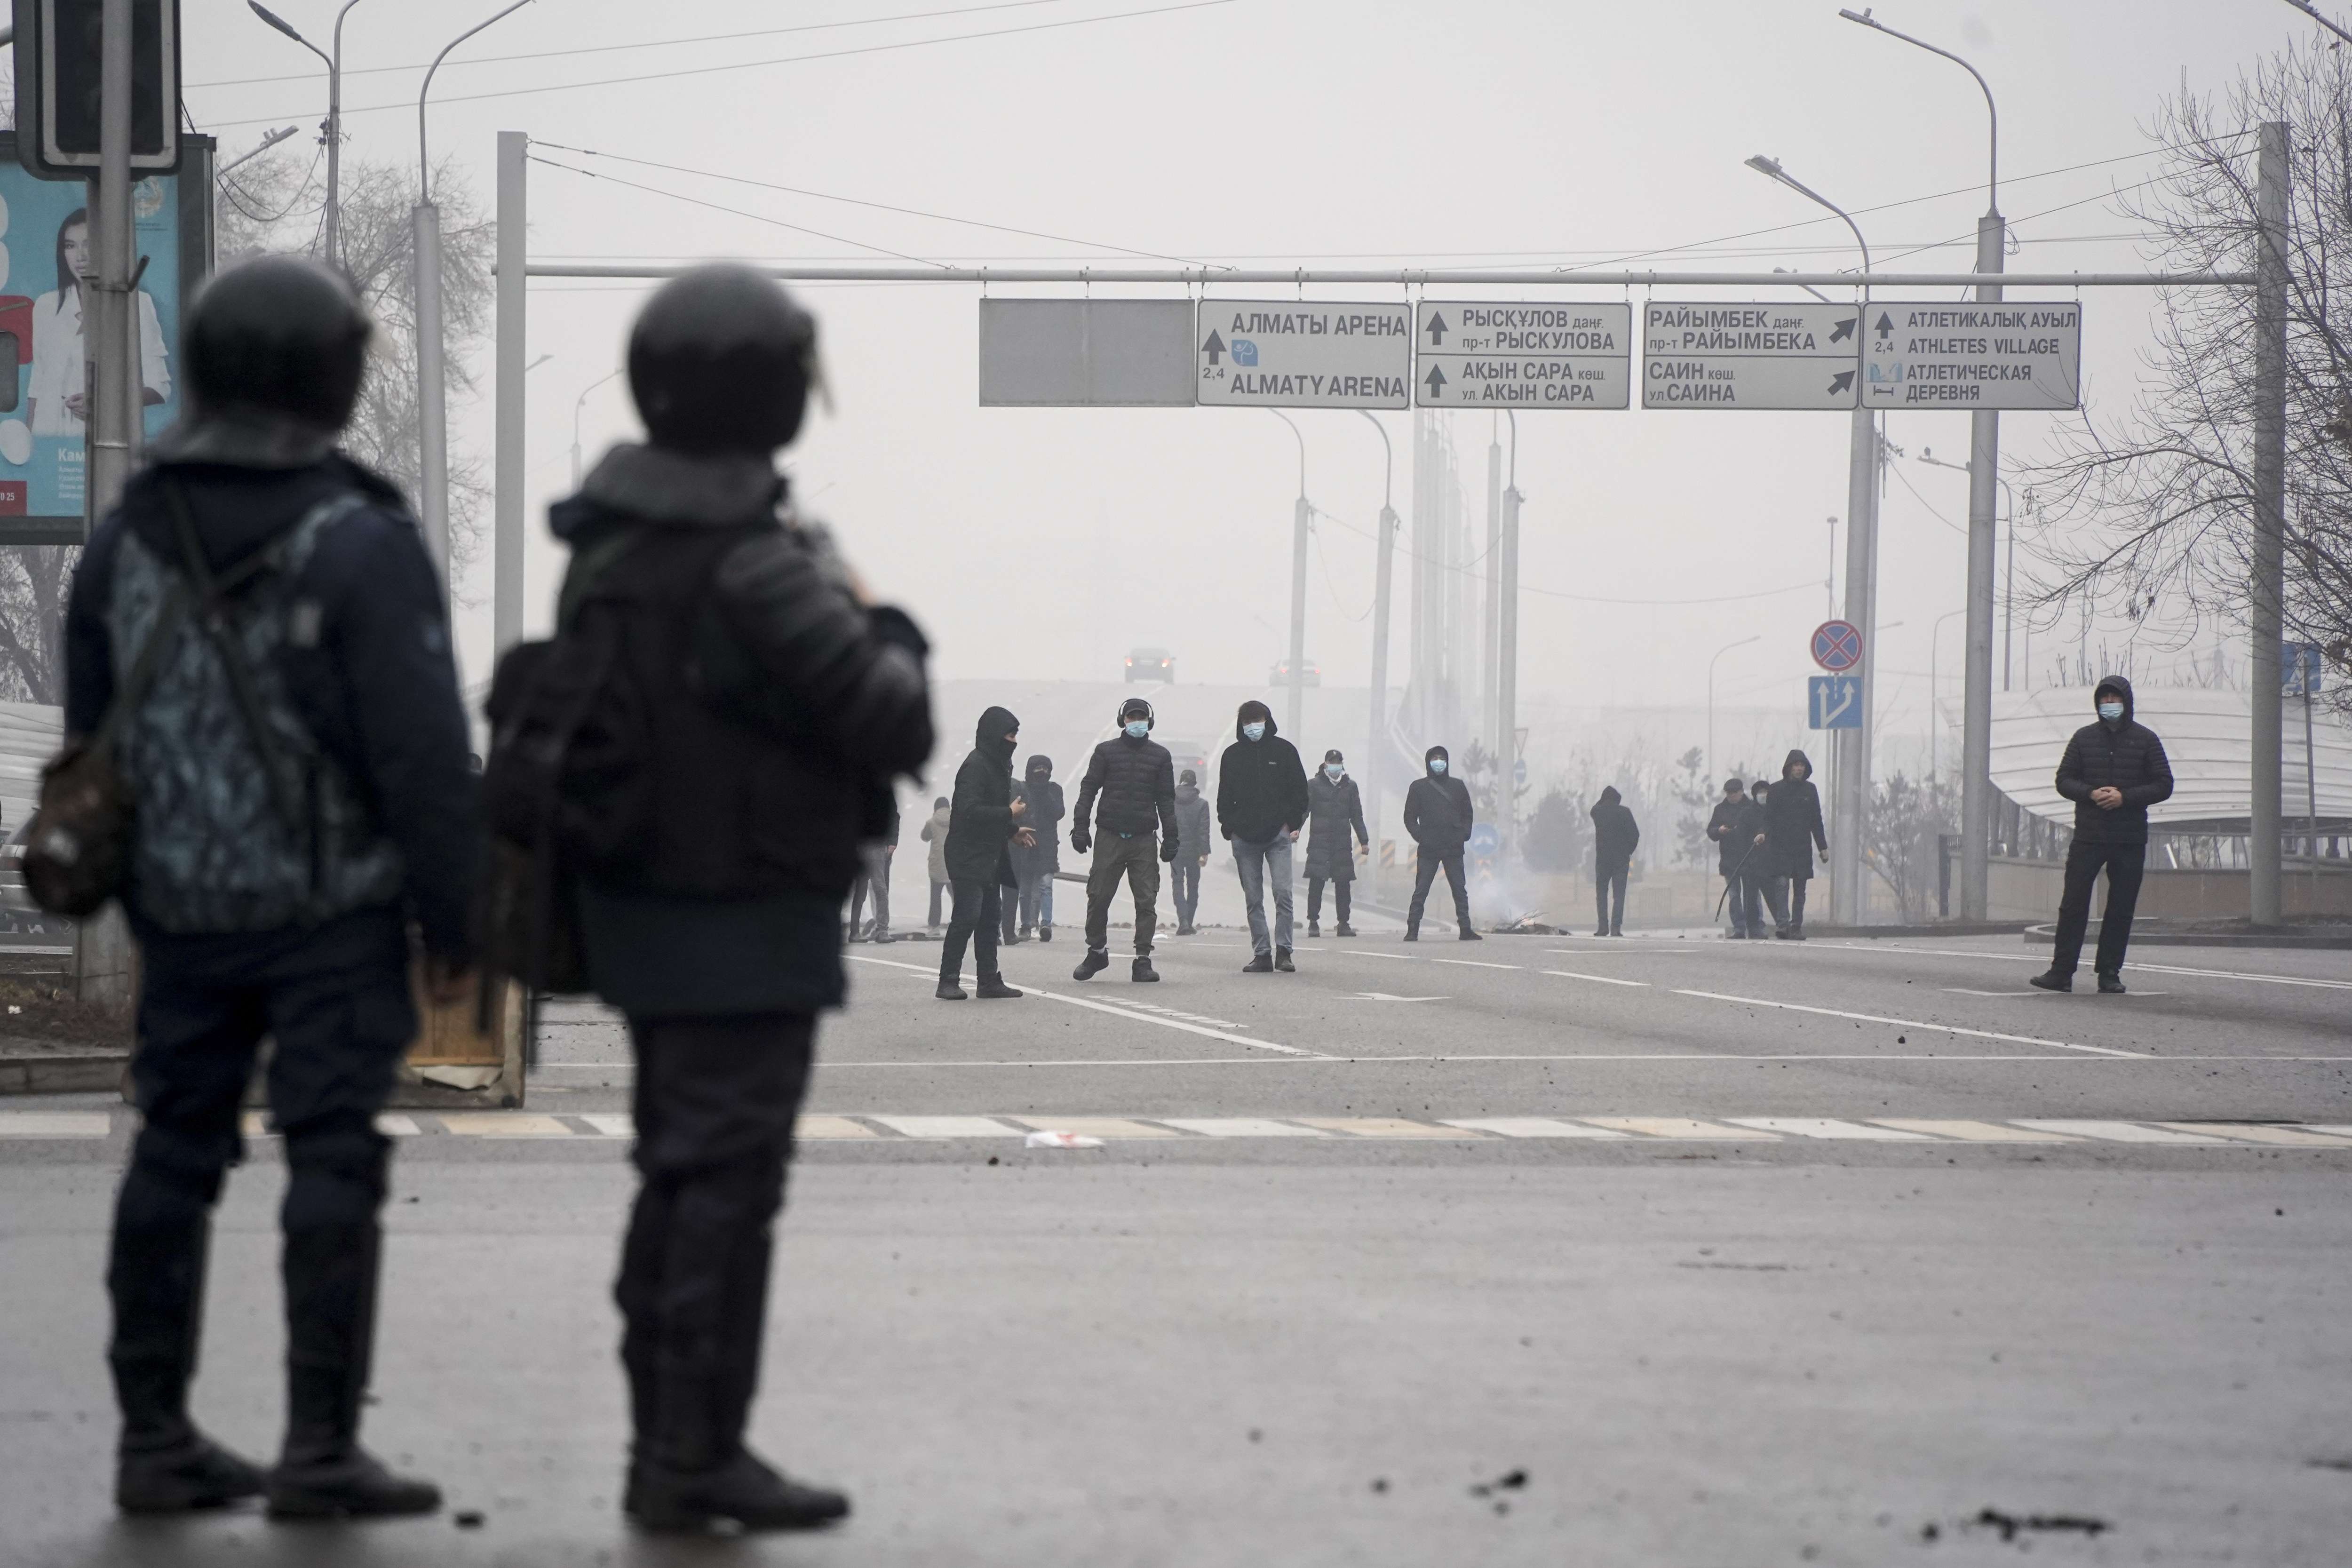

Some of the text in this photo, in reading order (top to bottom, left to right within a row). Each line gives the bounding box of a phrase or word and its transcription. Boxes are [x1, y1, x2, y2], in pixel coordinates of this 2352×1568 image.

[1231, 313, 1406, 336] АЛМАТЫ АРЕНА
[1463, 309, 1567, 330] РЫСҚҰЛОВ
[1650, 306, 1768, 328] РАЙЫМБЕК
[1907, 312, 2076, 330] АТЛЕТИКАЛЫҚ АУЫЛ
[1462, 331, 1615, 351] пр-т РЫСКУЛОВА
[1650, 328, 1817, 352] пр-т РАЙЫМБЕКА
[1875, 341, 1894, 354] 2,4
[1908, 338, 2060, 355] ATHLETES VILLAGE
[1203, 367, 1225, 381] 2,4
[1462, 361, 1606, 381] АҚЫН САРА көш.
[1649, 362, 1736, 380] САИН көш.
[1907, 364, 2032, 381] АТЛЕТИЧЕСКАЯ
[1230, 374, 1406, 398] ALMATY ARENA
[1462, 383, 1595, 401] ул. АКЫН САРА
[1650, 383, 1736, 401] ул. САИНА
[1906, 384, 1980, 403] ДЕРЕВНЯ
[7, 492, 15, 501] 25
